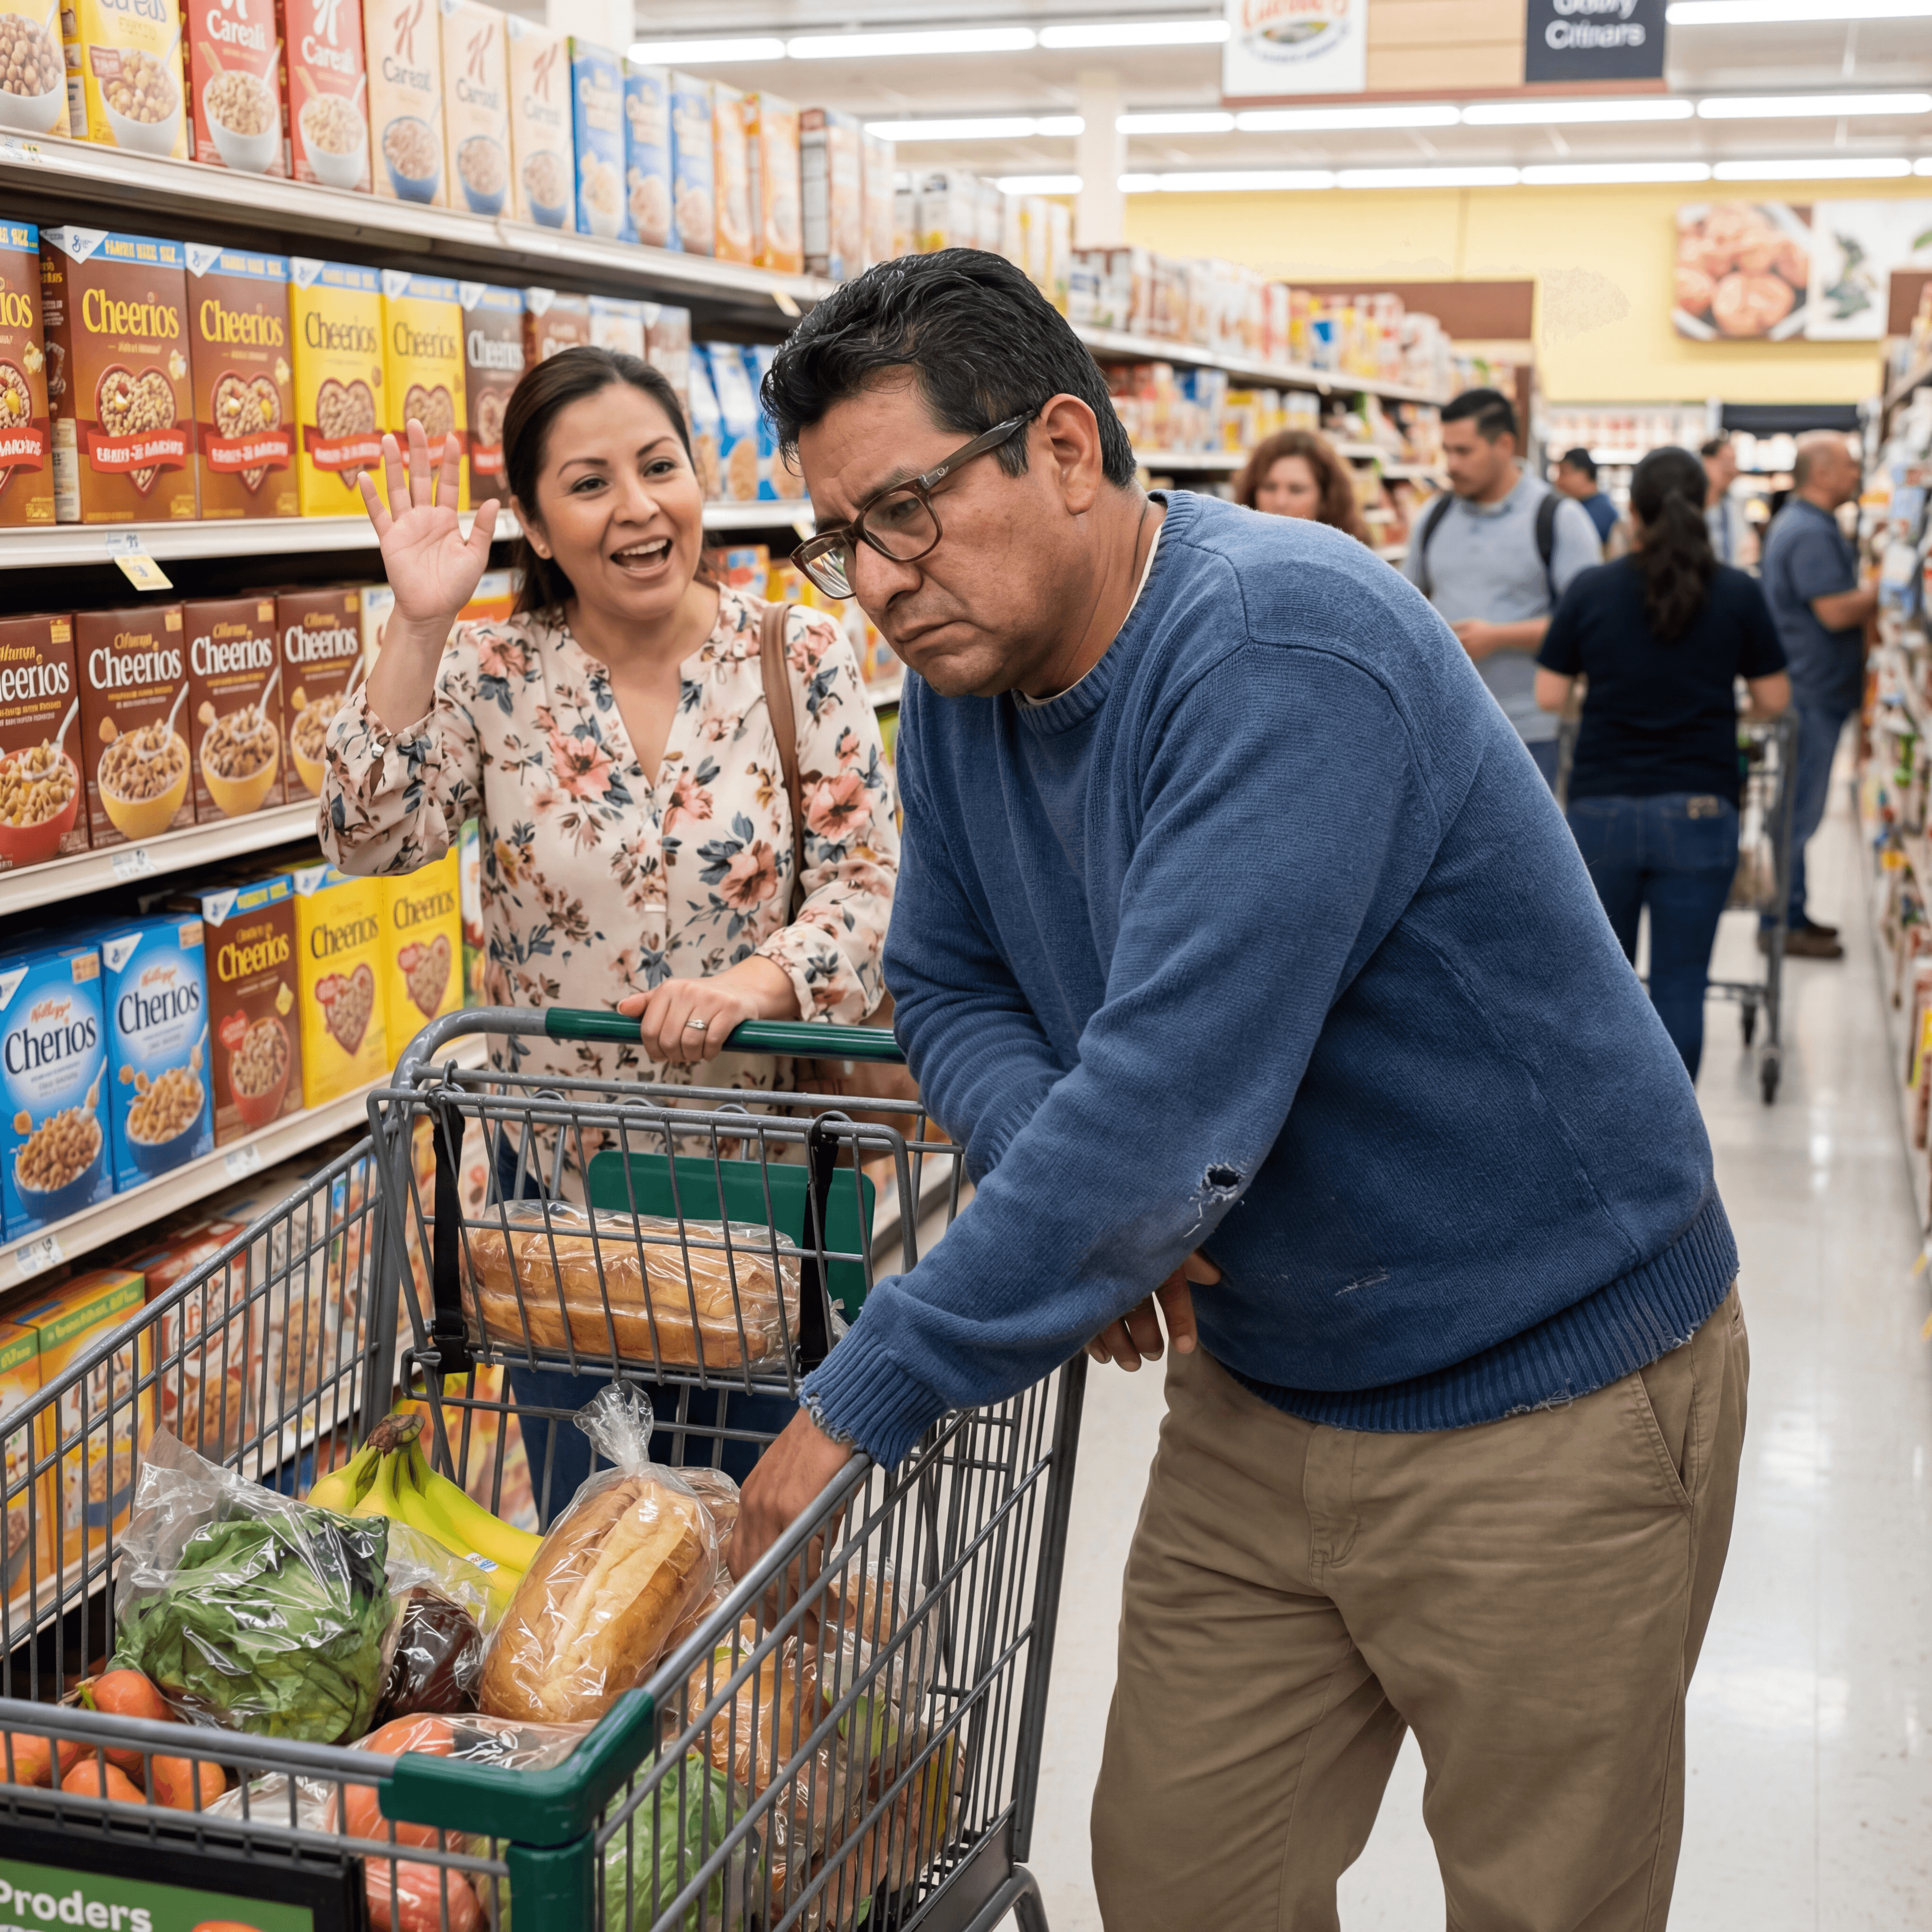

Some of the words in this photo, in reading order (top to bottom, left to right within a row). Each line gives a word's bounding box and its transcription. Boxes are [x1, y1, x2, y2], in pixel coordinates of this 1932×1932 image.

[83, 288, 180, 339] Cheerios
[200, 299, 284, 347] Cheerios
[305, 310, 377, 353] Cheerios
[191, 635, 273, 676] Cheerios
[285, 624, 358, 664] Cheerios
[0, 661, 70, 702] eerios
[88, 647, 183, 689] Cheerios
[217, 933, 290, 982] Cheerios
[310, 913, 379, 960] Cheerios
[118, 980, 200, 1035] Cherios
[5, 1016, 97, 1076] Cherios
